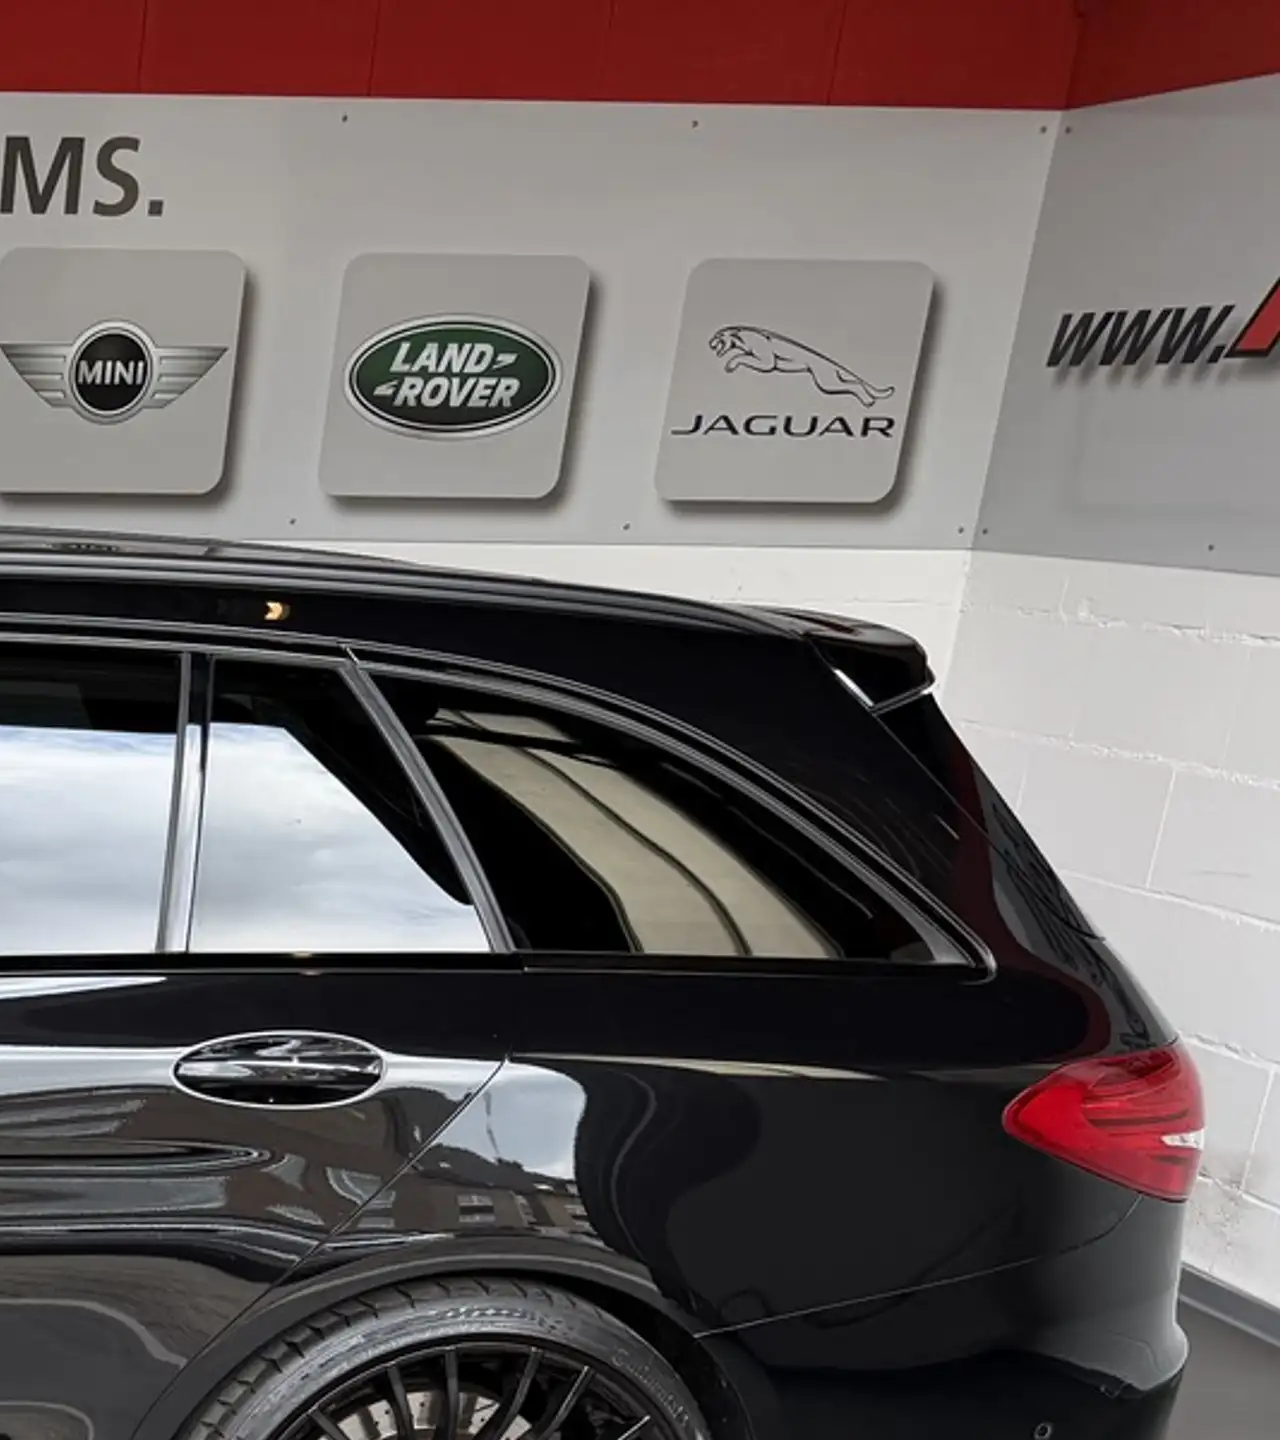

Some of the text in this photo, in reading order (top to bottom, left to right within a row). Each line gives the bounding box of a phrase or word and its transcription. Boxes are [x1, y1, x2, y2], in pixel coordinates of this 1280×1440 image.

[389, 341, 495, 374] LAND
[77, 359, 145, 386] MINI
[392, 376, 521, 408] ROVER
[670, 414, 896, 438] JAGUAR
